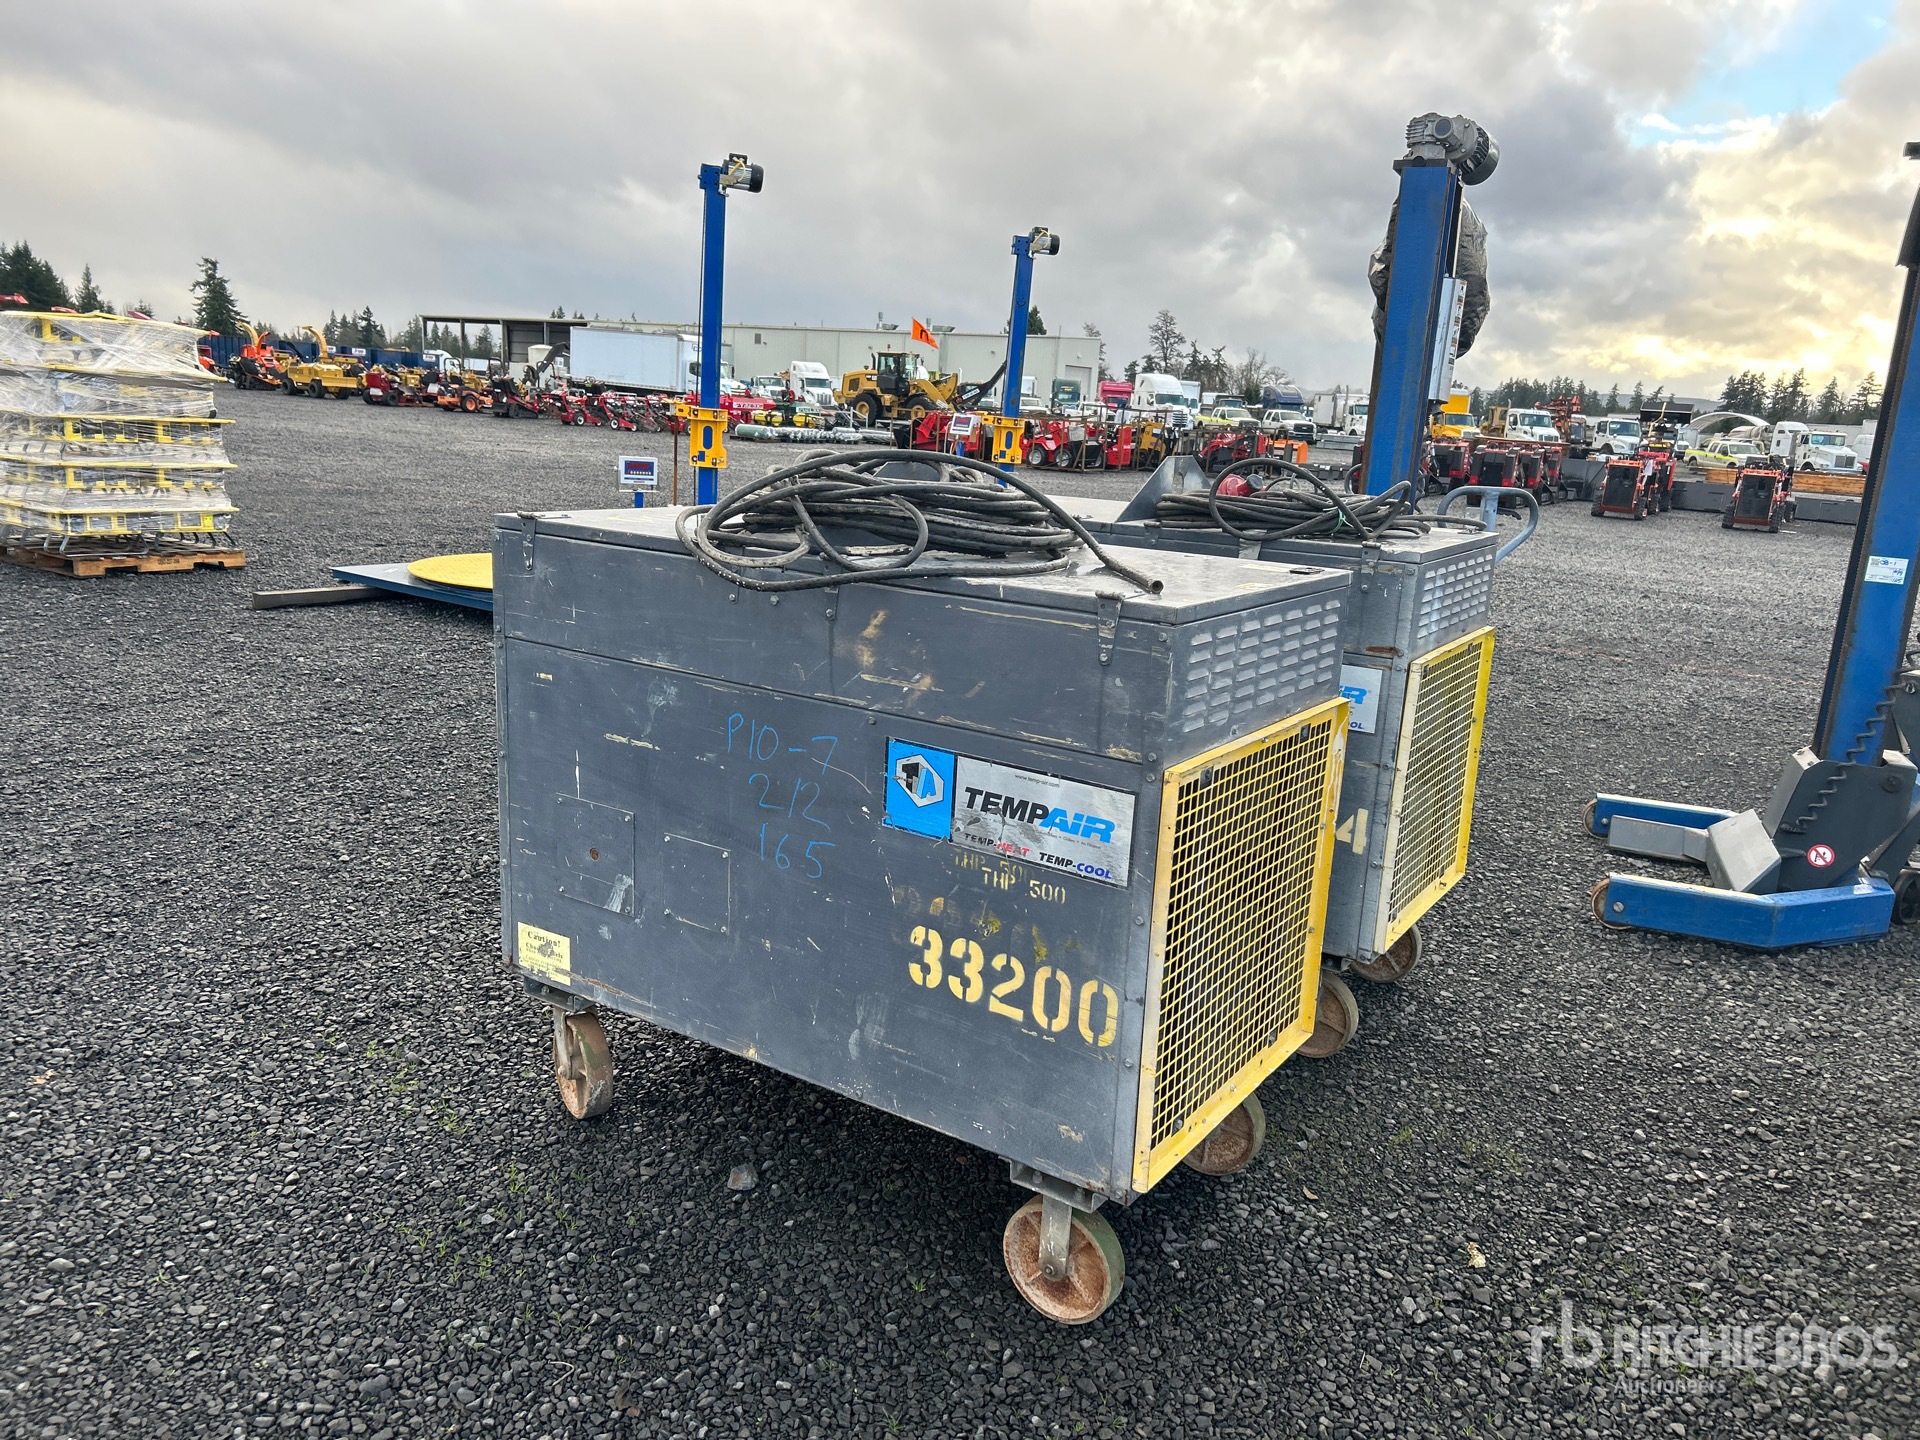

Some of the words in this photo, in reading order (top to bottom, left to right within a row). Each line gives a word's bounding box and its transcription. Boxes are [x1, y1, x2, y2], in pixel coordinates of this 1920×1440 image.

[727, 712, 838, 775] P10-7
[759, 822, 836, 879] 165
[1039, 851, 1112, 880] TEMP-COOL
[981, 866, 1016, 891] THP
[1029, 879, 1067, 905] 500
[908, 925, 1119, 1048] 33200
